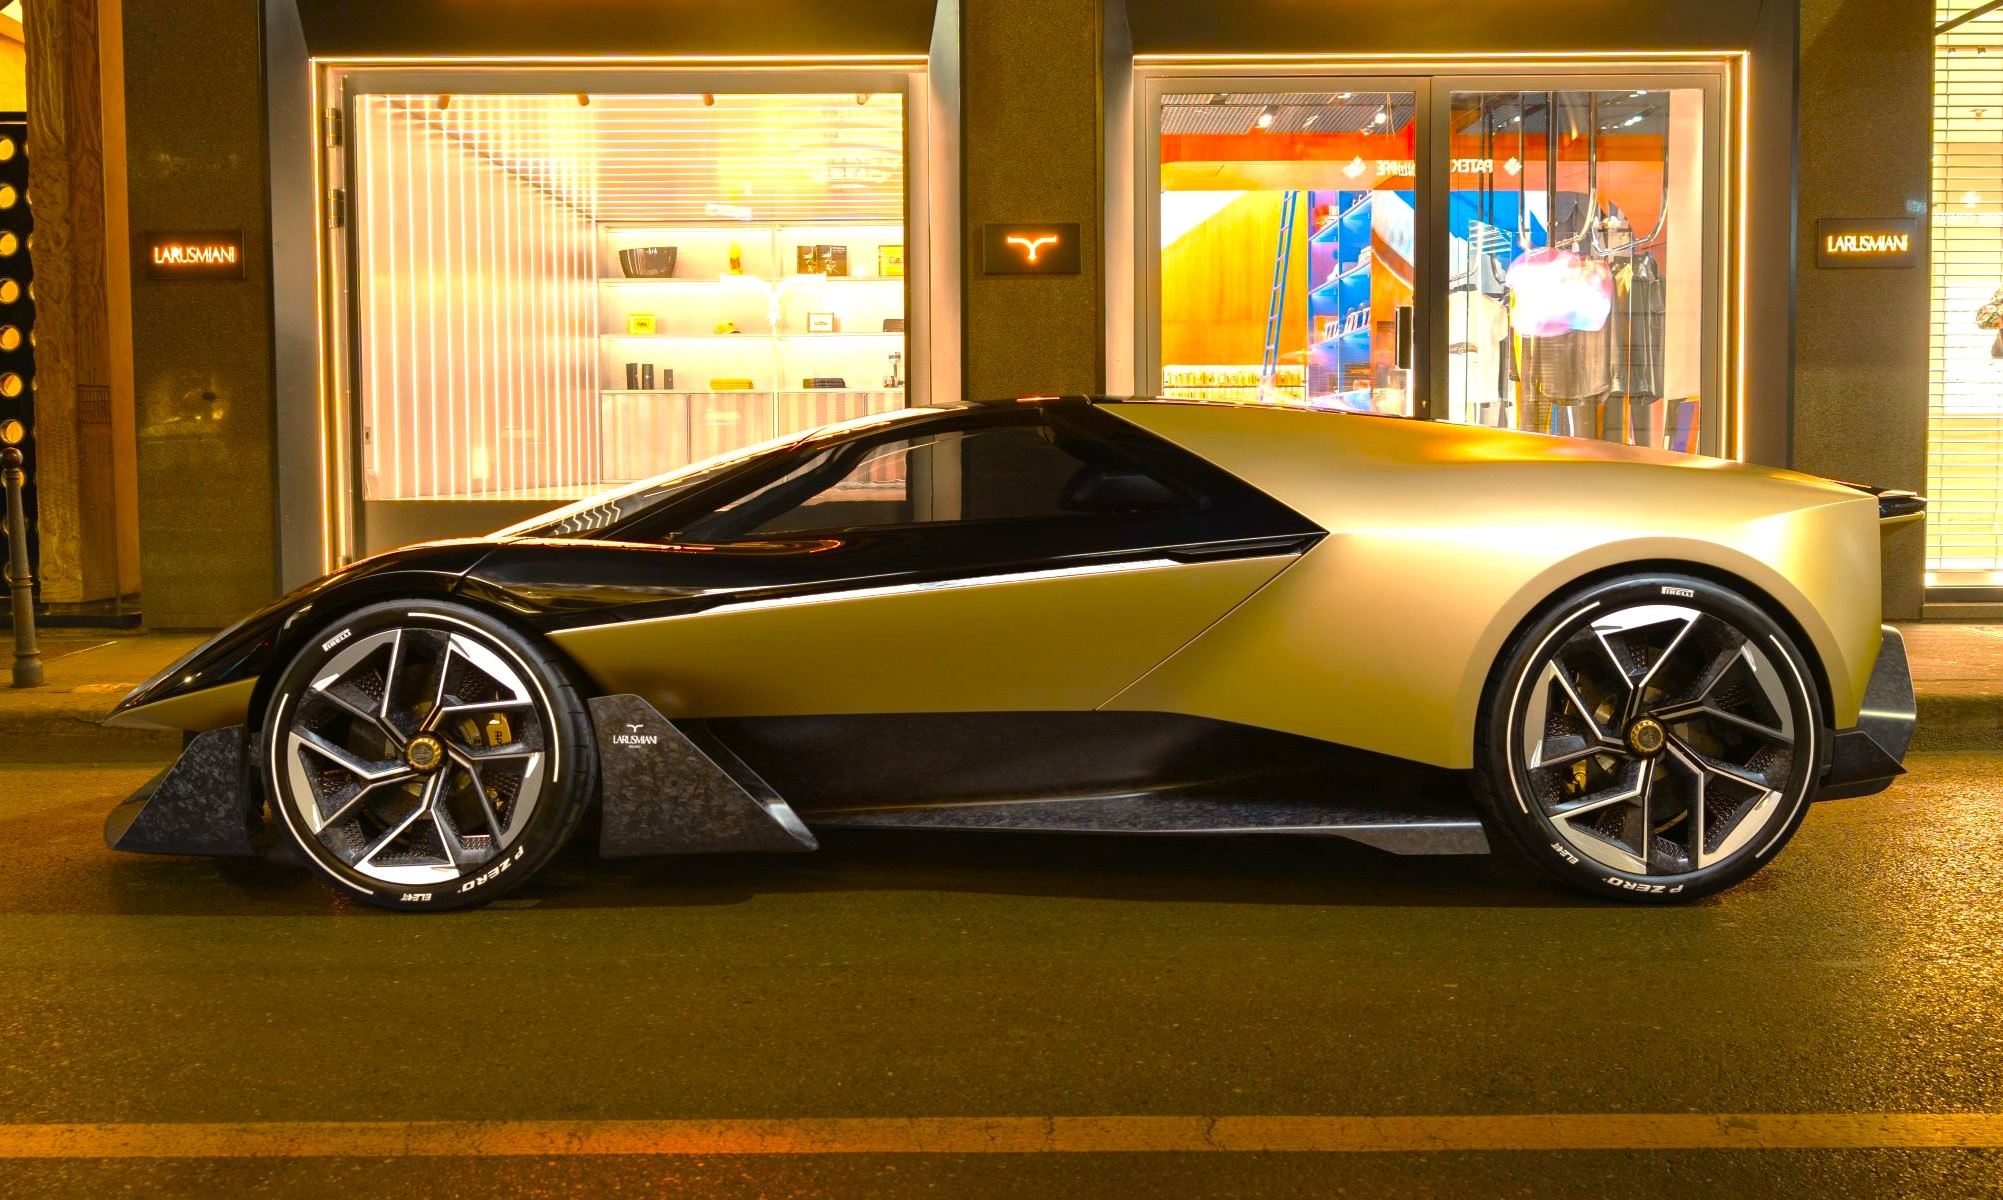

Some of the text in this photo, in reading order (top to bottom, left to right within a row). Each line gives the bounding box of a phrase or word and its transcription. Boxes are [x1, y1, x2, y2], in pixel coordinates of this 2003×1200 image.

[1827, 234, 1908, 252] LARUSMIANI
[154, 246, 235, 263] LARUSMIANI
[1661, 586, 1694, 598] PIRELLI
[322, 628, 352, 652] PIRELLI
[613, 735, 658, 745] LARUSMIANI
[462, 845, 524, 892] P ZERO
[1607, 877, 1684, 894] P ZERO
